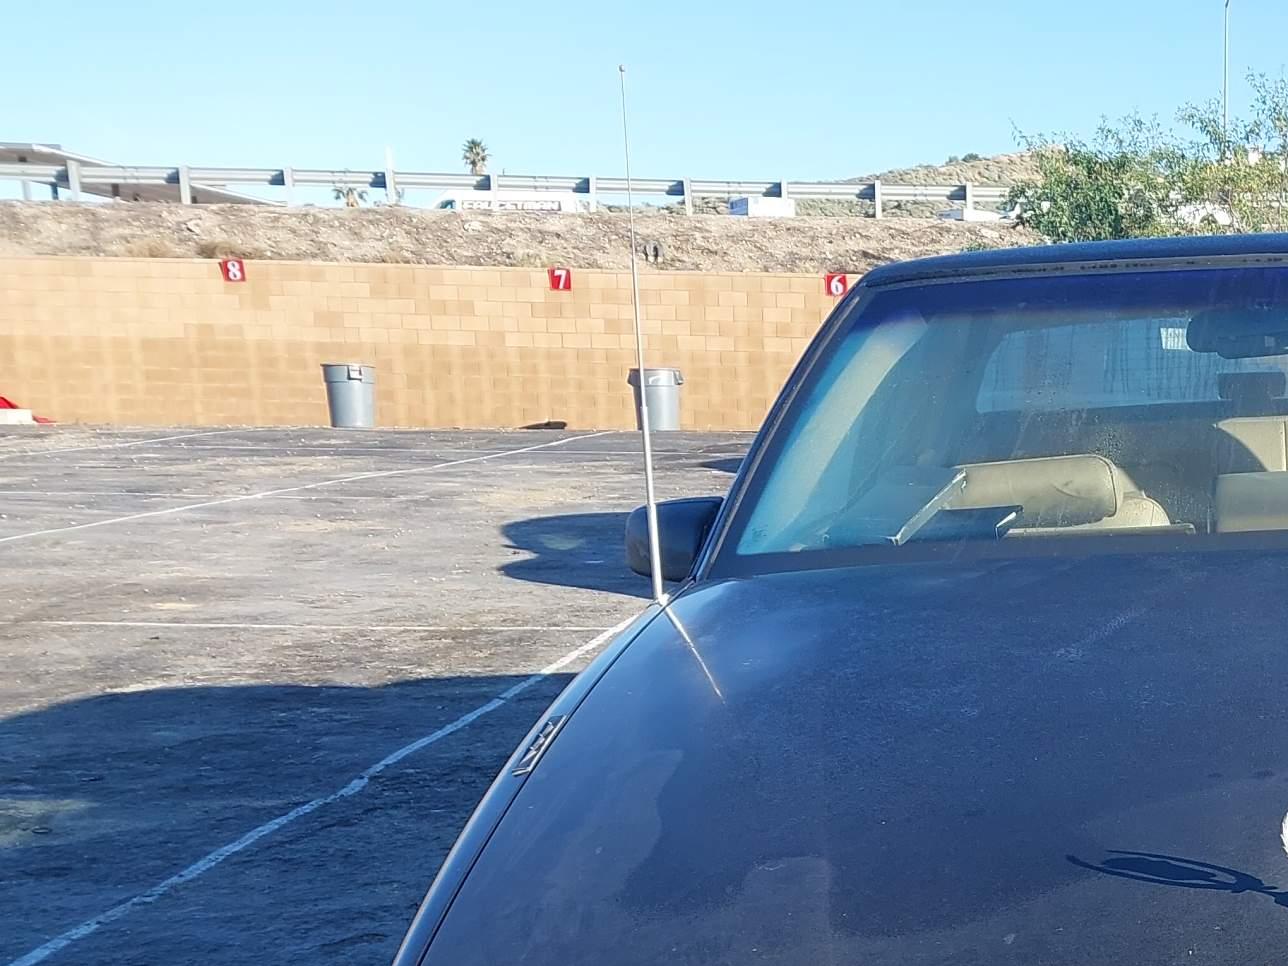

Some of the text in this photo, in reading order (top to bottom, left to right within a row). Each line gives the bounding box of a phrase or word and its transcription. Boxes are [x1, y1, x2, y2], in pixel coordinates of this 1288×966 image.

[227, 260, 241, 280] 8
[554, 269, 567, 289] 7
[830, 274, 844, 295] 6
